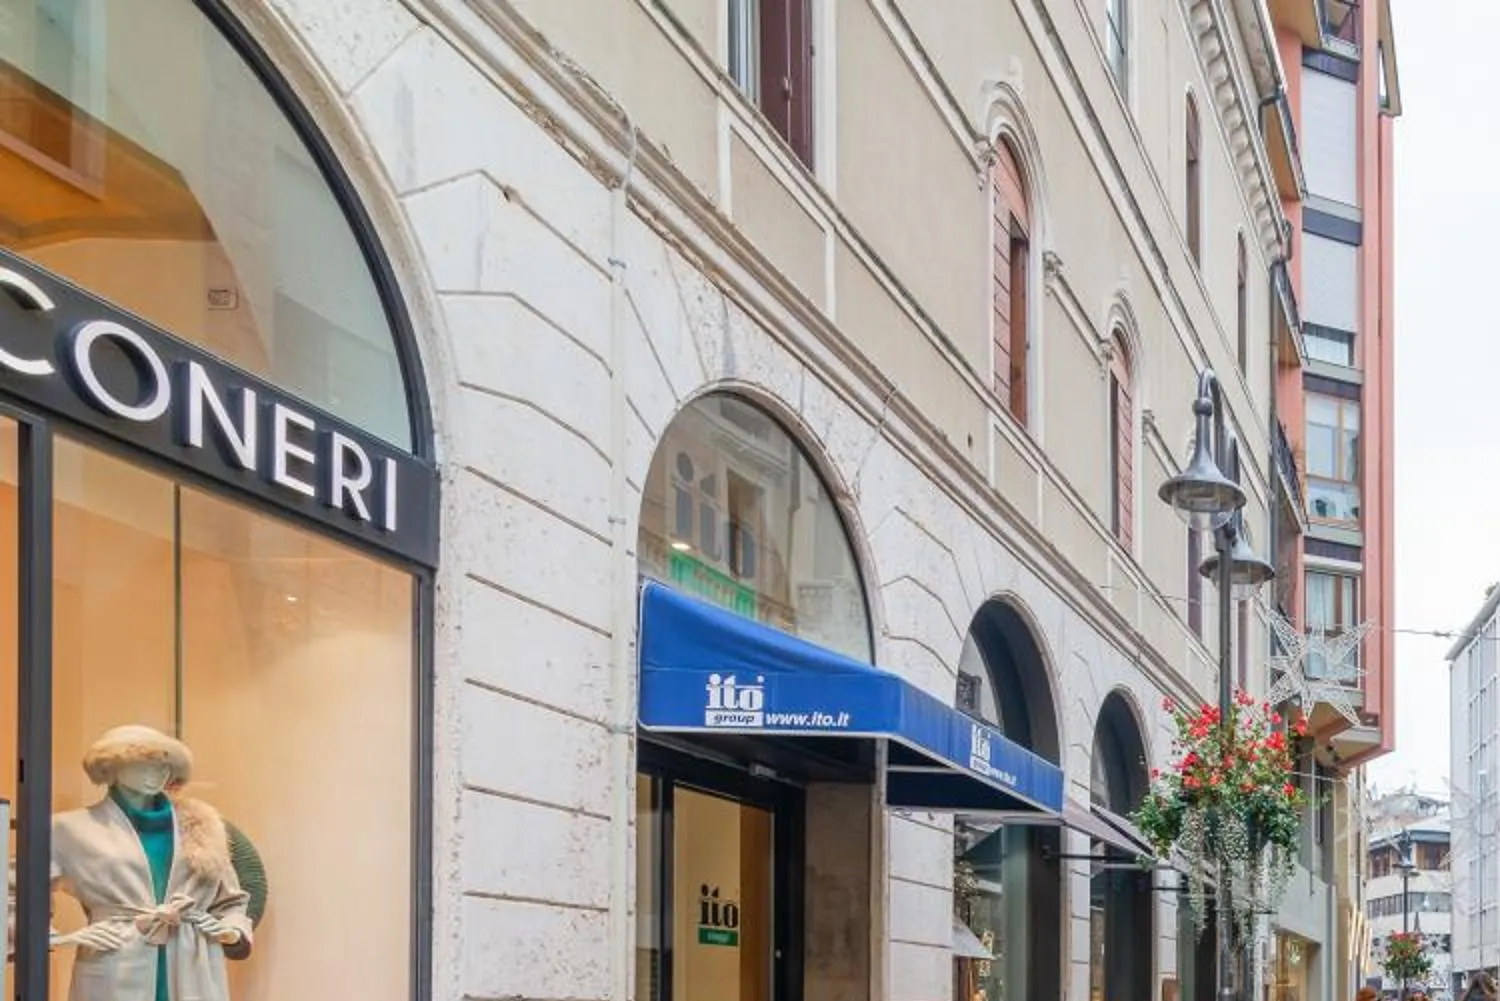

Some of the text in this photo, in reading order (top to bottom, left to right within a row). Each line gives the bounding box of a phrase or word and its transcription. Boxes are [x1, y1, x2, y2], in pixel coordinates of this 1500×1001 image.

[705, 673, 765, 711] ito
[714, 713, 755, 726] group
[766, 711, 849, 727] www.ito.it
